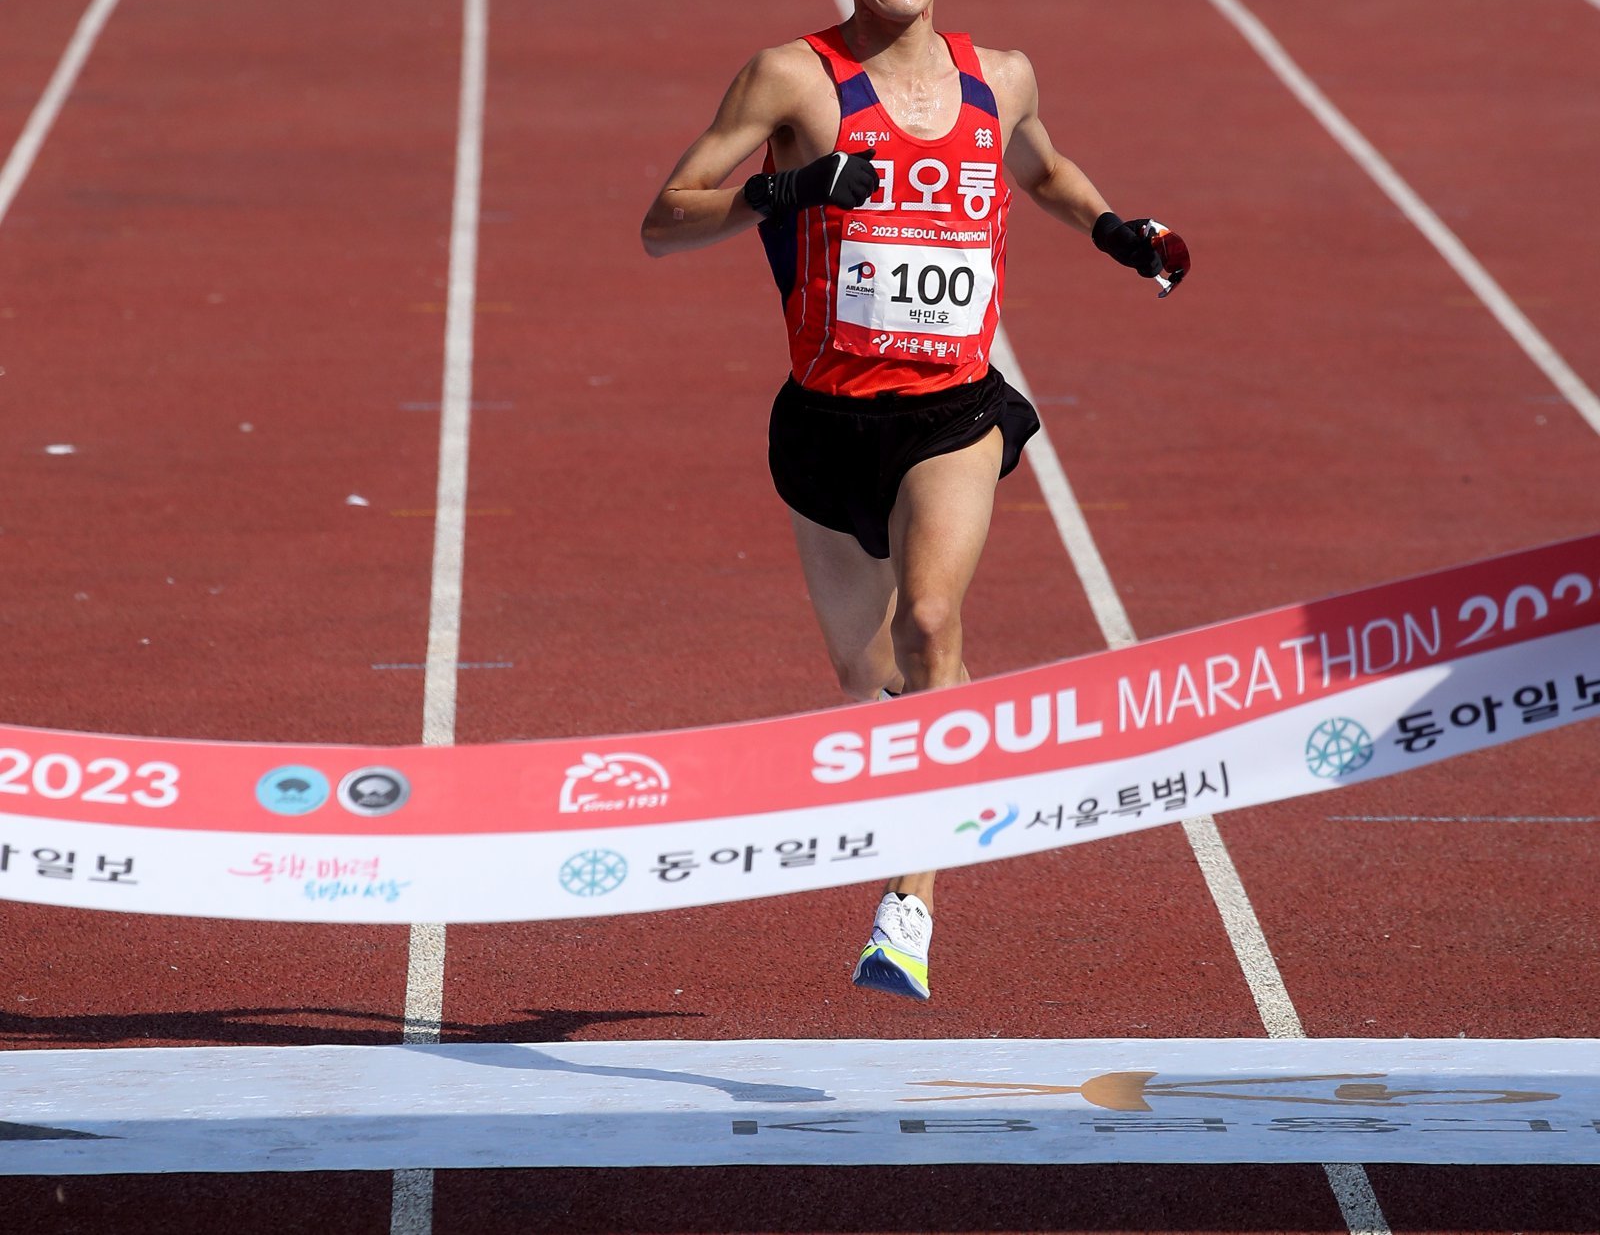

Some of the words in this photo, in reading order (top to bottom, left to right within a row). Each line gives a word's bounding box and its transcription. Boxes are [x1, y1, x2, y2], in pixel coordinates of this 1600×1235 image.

[849, 130, 890, 147] 세종시
[871, 226, 898, 237] 2023
[900, 227, 937, 240] SEOUL
[940, 228, 988, 242] MARATHON
[845, 285, 875, 294] AMAZING
[890, 263, 975, 306] 100
[909, 309, 949, 324] 박민호
[894, 338, 961, 357] 서울특별시
[811, 688, 1103, 784] SEOUL
[1117, 606, 1441, 733] MARATHON
[0, 748, 181, 808] 2023
[583, 799, 624, 813] since
[626, 793, 668, 810] 1931
[1025, 761, 1230, 833] 서울특별시
[650, 832, 878, 883] 동아일보
[732, 1116, 1600, 1135] KB금융그
